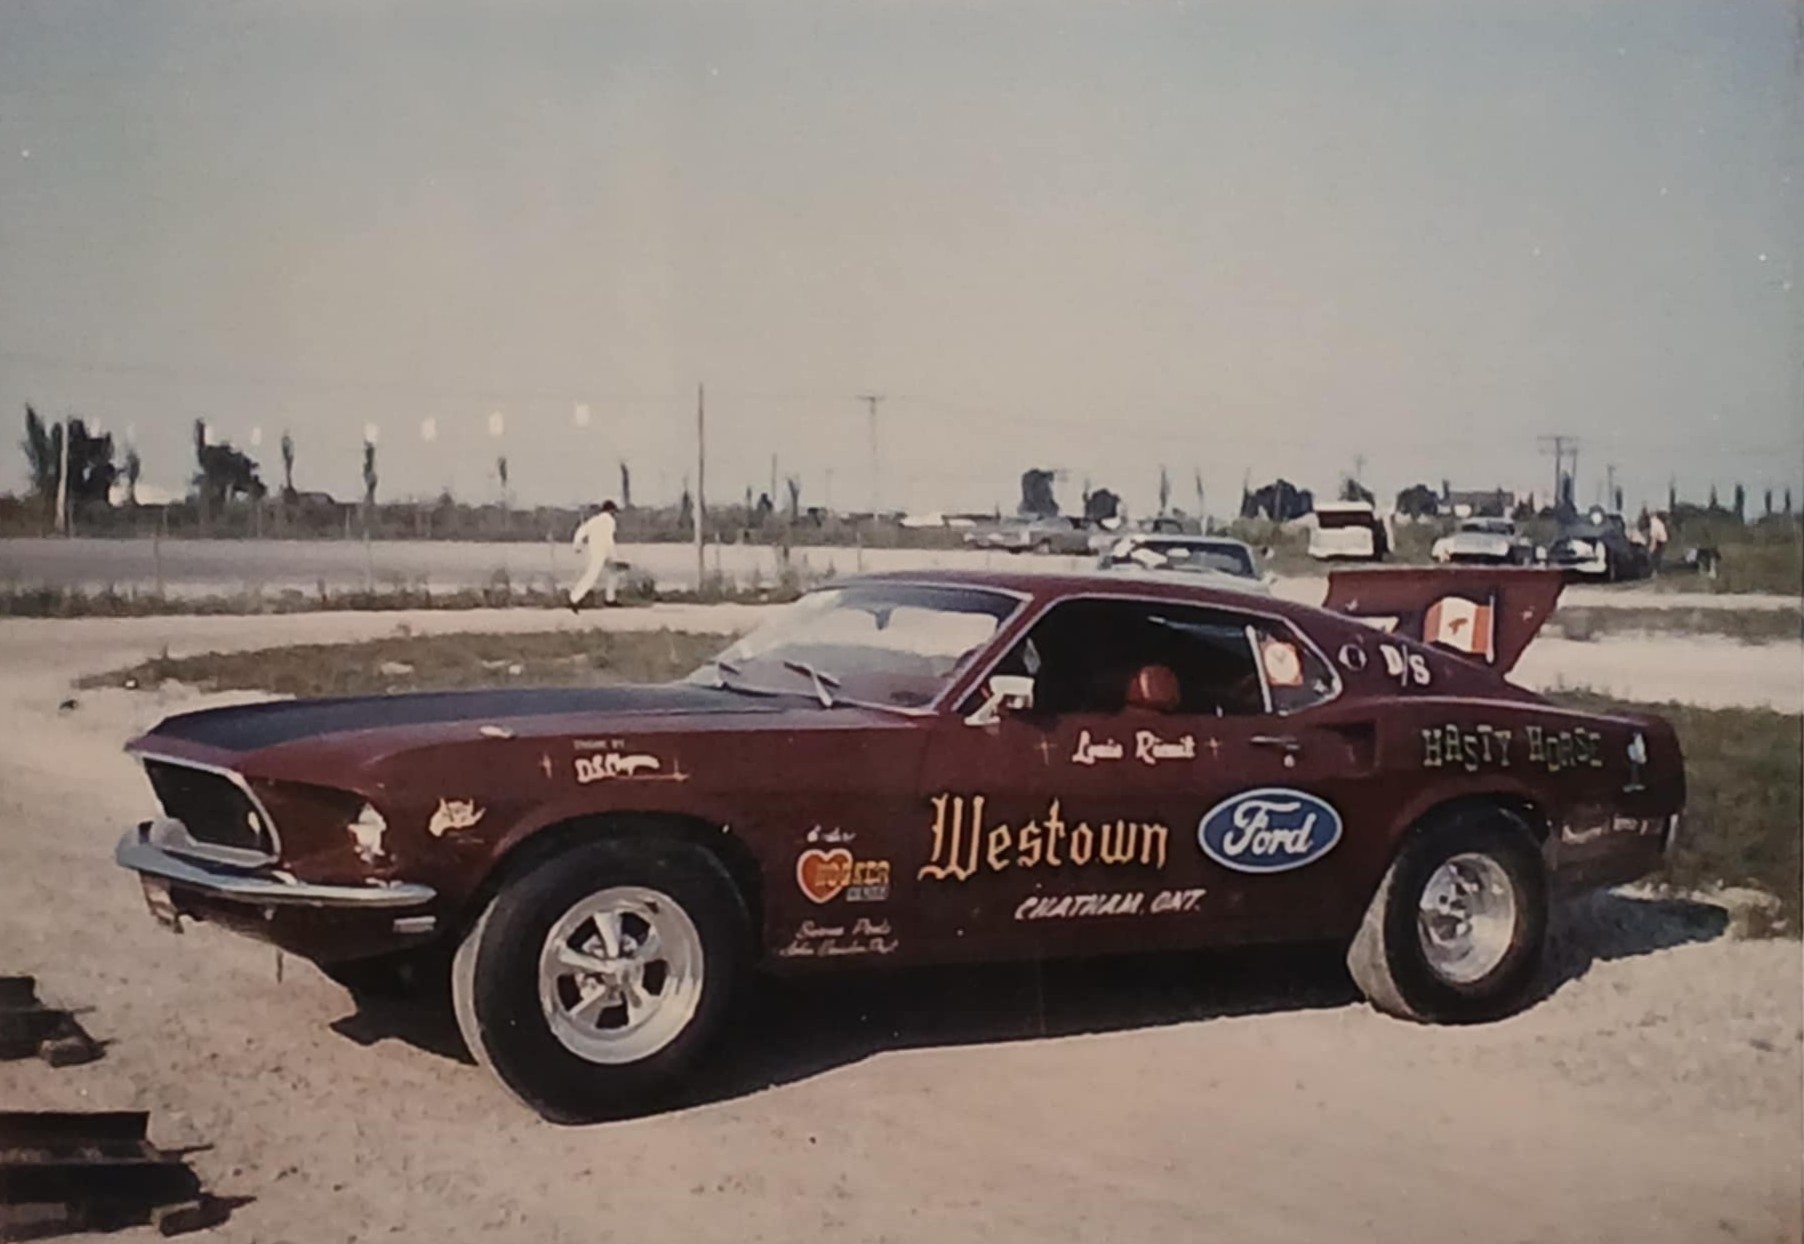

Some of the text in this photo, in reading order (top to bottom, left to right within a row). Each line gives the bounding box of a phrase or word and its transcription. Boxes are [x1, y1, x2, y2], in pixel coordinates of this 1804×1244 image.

[1422, 724, 1512, 772] HASTY
[917, 792, 1170, 882] Westown
[1223, 798, 1316, 857] Ford
